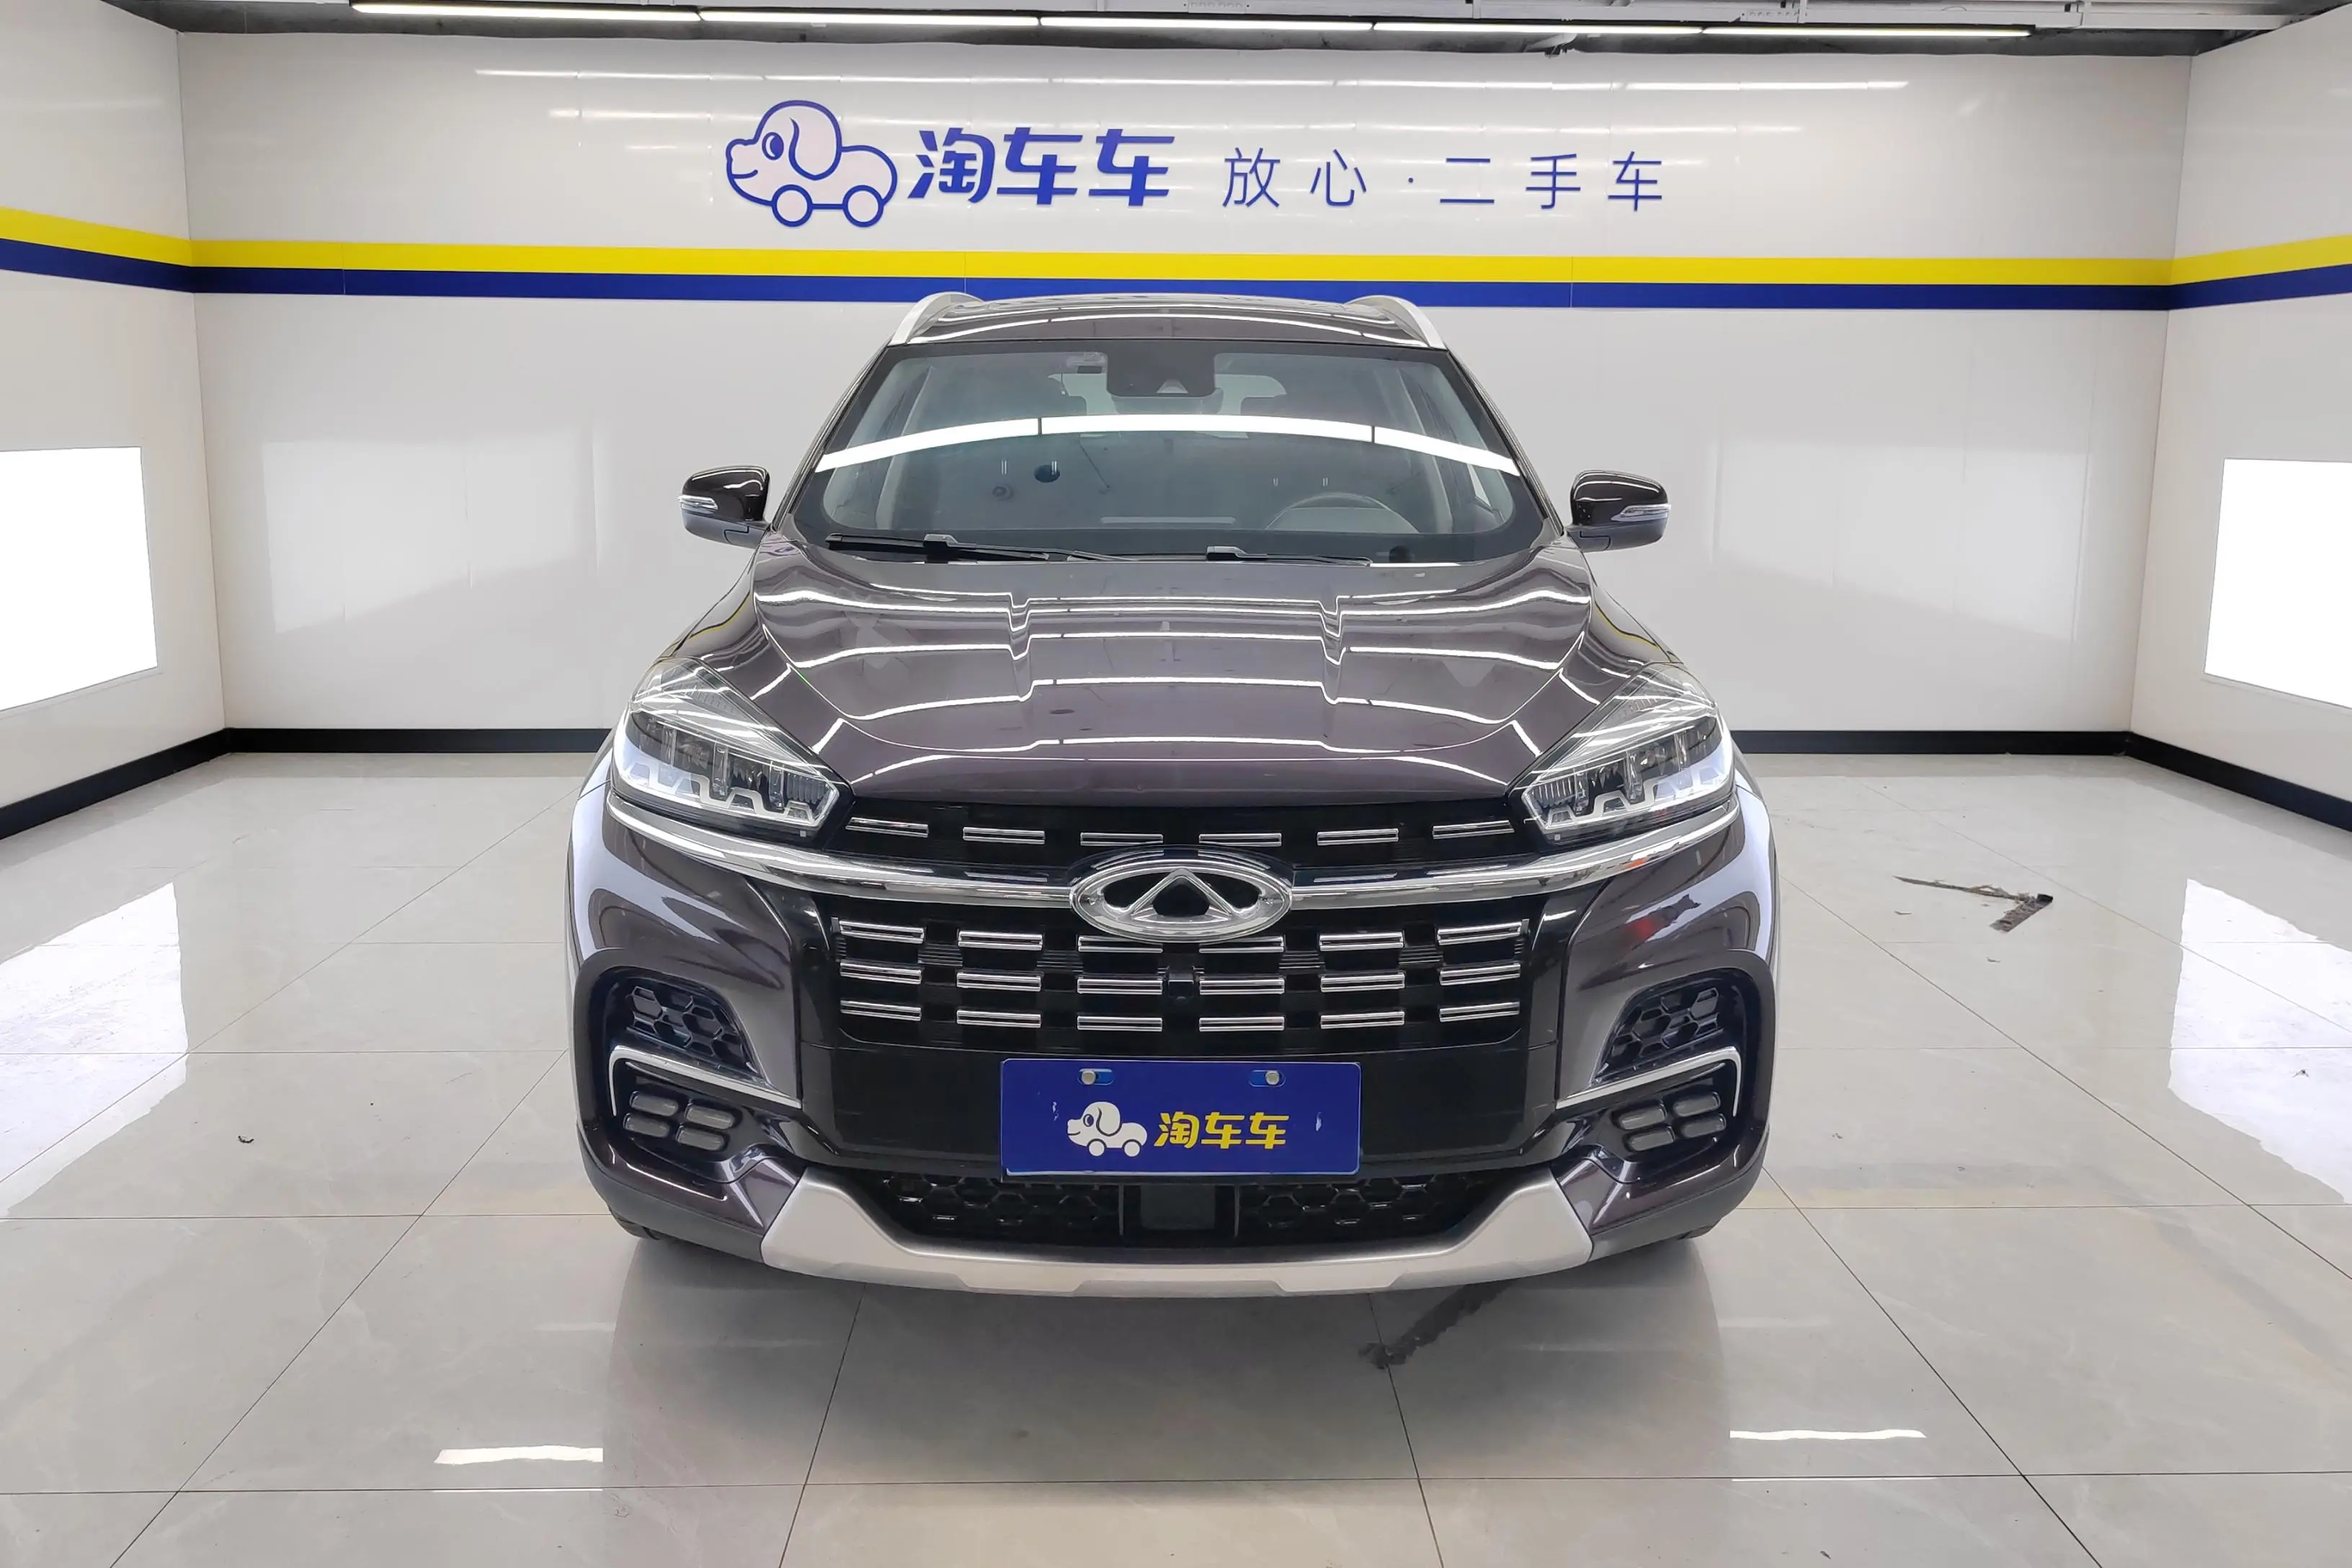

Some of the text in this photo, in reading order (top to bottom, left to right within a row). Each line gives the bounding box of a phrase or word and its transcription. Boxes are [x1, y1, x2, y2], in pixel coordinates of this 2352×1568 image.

[909, 127, 1175, 207] 淘车车
[1154, 1111, 1289, 1149] 淘车车
